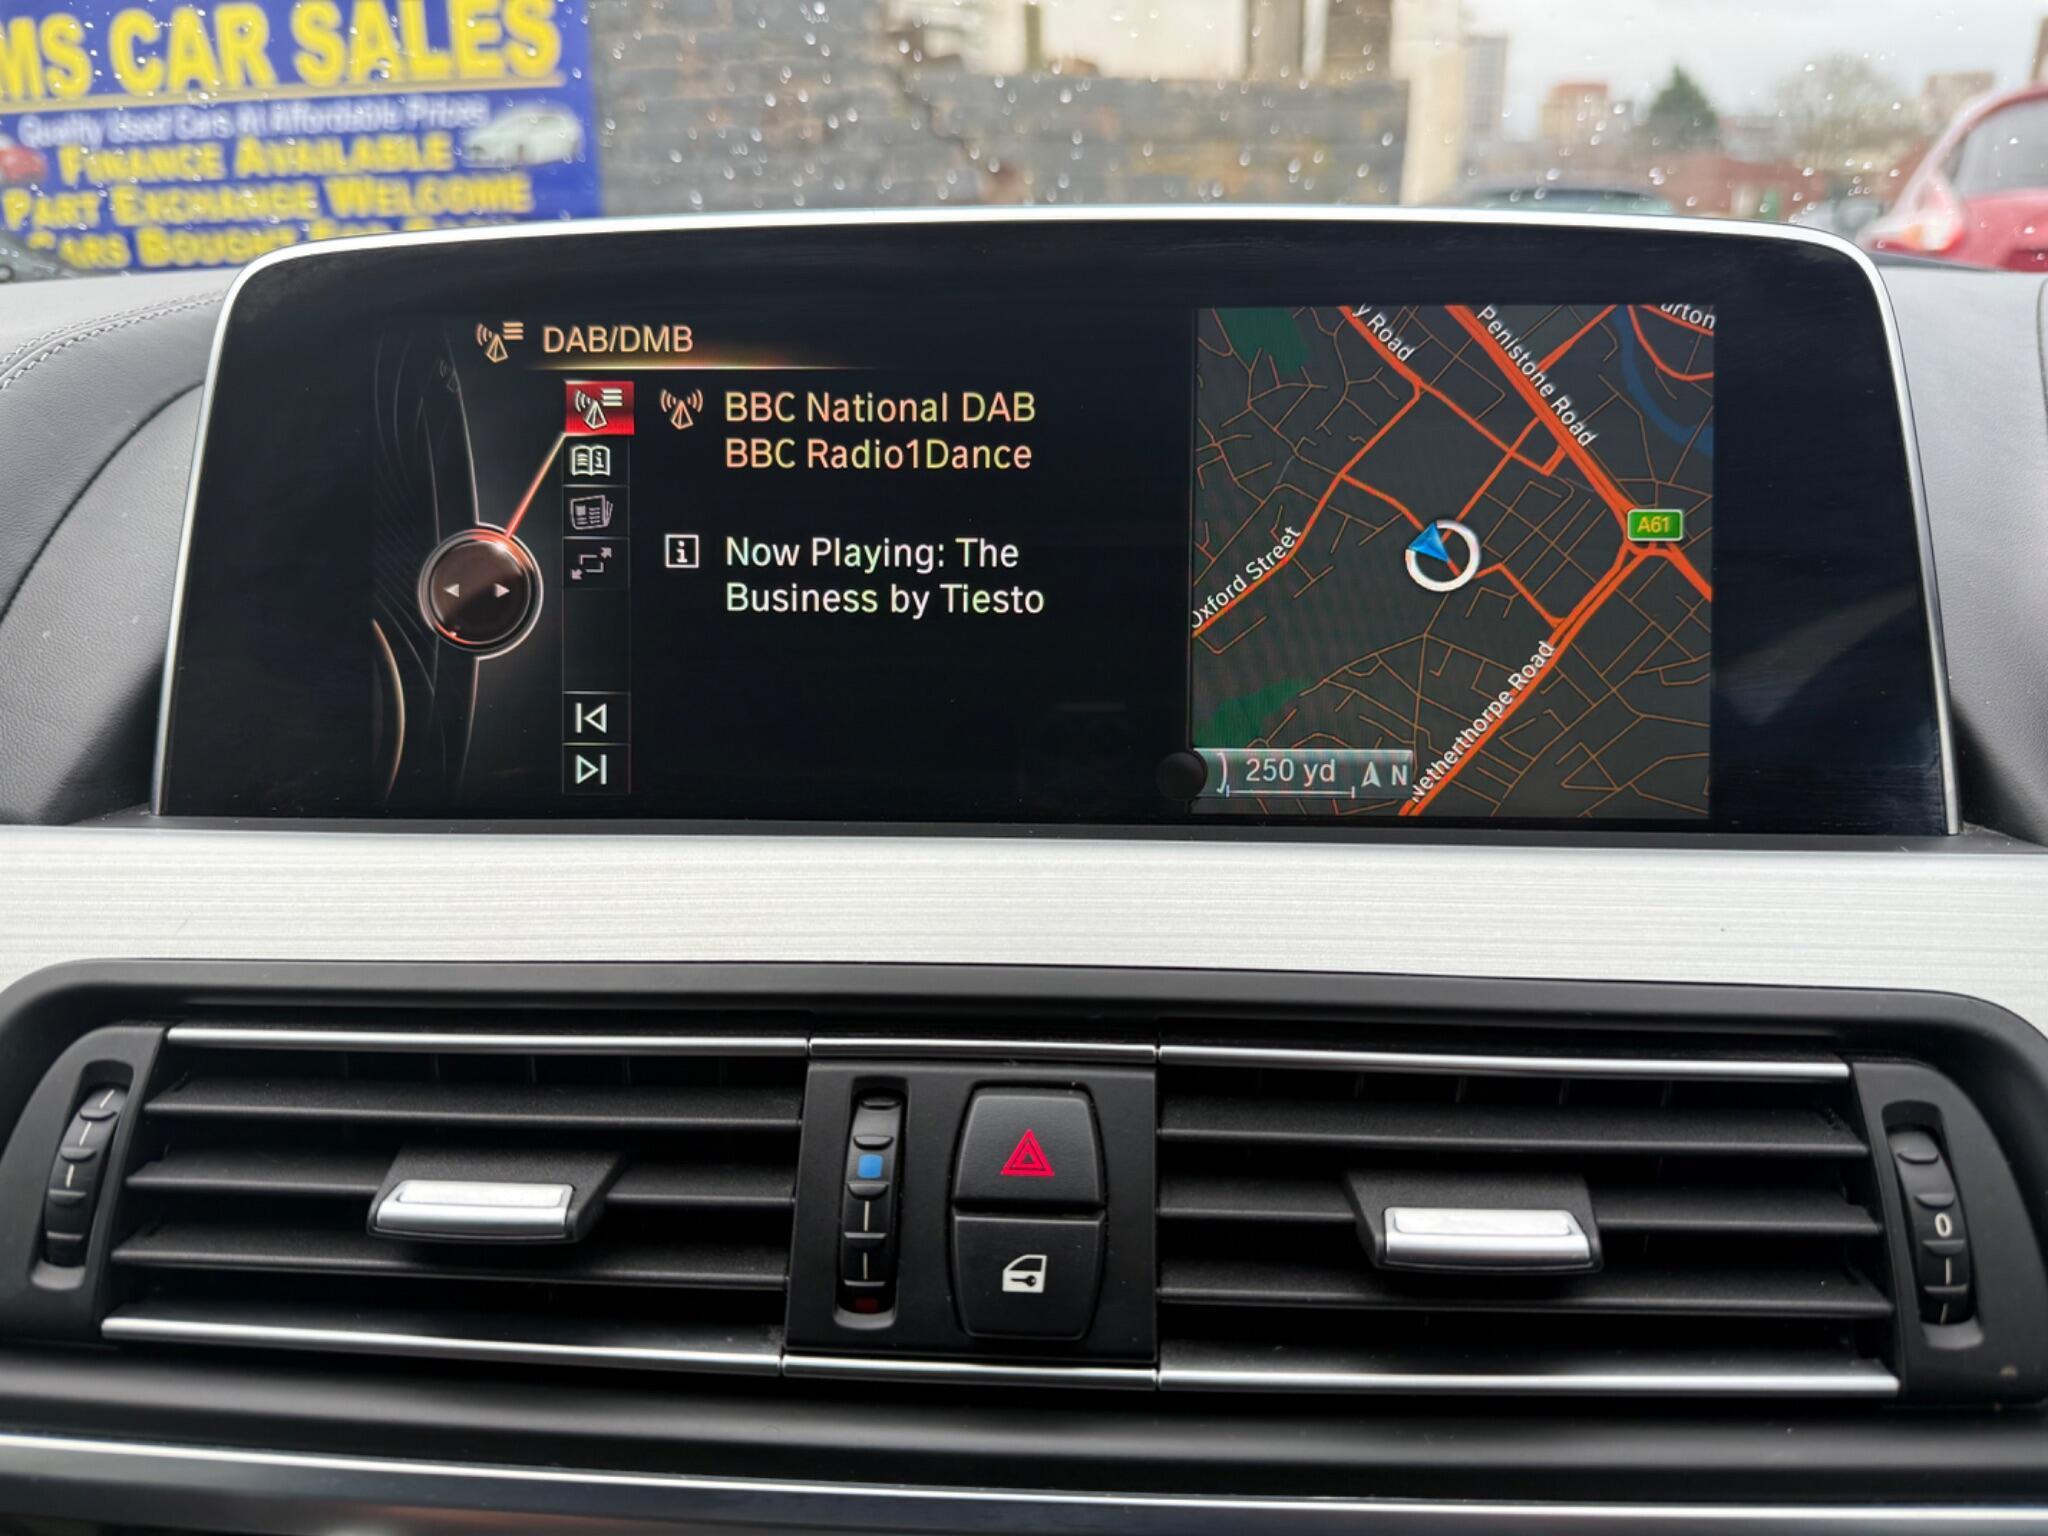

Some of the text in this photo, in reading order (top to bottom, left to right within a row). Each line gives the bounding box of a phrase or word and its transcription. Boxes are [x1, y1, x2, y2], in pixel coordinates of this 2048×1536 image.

[109, 3, 278, 96] CAR
[291, 0, 562, 87] SALES
[18, 112, 102, 150] Quality
[106, 107, 172, 143] Used
[174, 103, 235, 140] Cars
[270, 98, 399, 134] Affordable
[401, 93, 490, 130] Prices
[543, 325, 693, 354] DAB/DMB
[1367, 312, 1416, 362] Road
[1477, 304, 1598, 447] Penistone Road
[726, 392, 1036, 423] BBC National DAB
[726, 438, 1032, 470] BBC Radio1Dance
[1637, 516, 1671, 533] A61
[726, 537, 1019, 575] Now Playing: The
[1245, 526, 1302, 581] Street
[726, 582, 1045, 620] Business by Tiesto
[1507, 640, 1555, 691] Road
[1246, 758, 1336, 787] 250 yd
[1391, 764, 1408, 786] N
